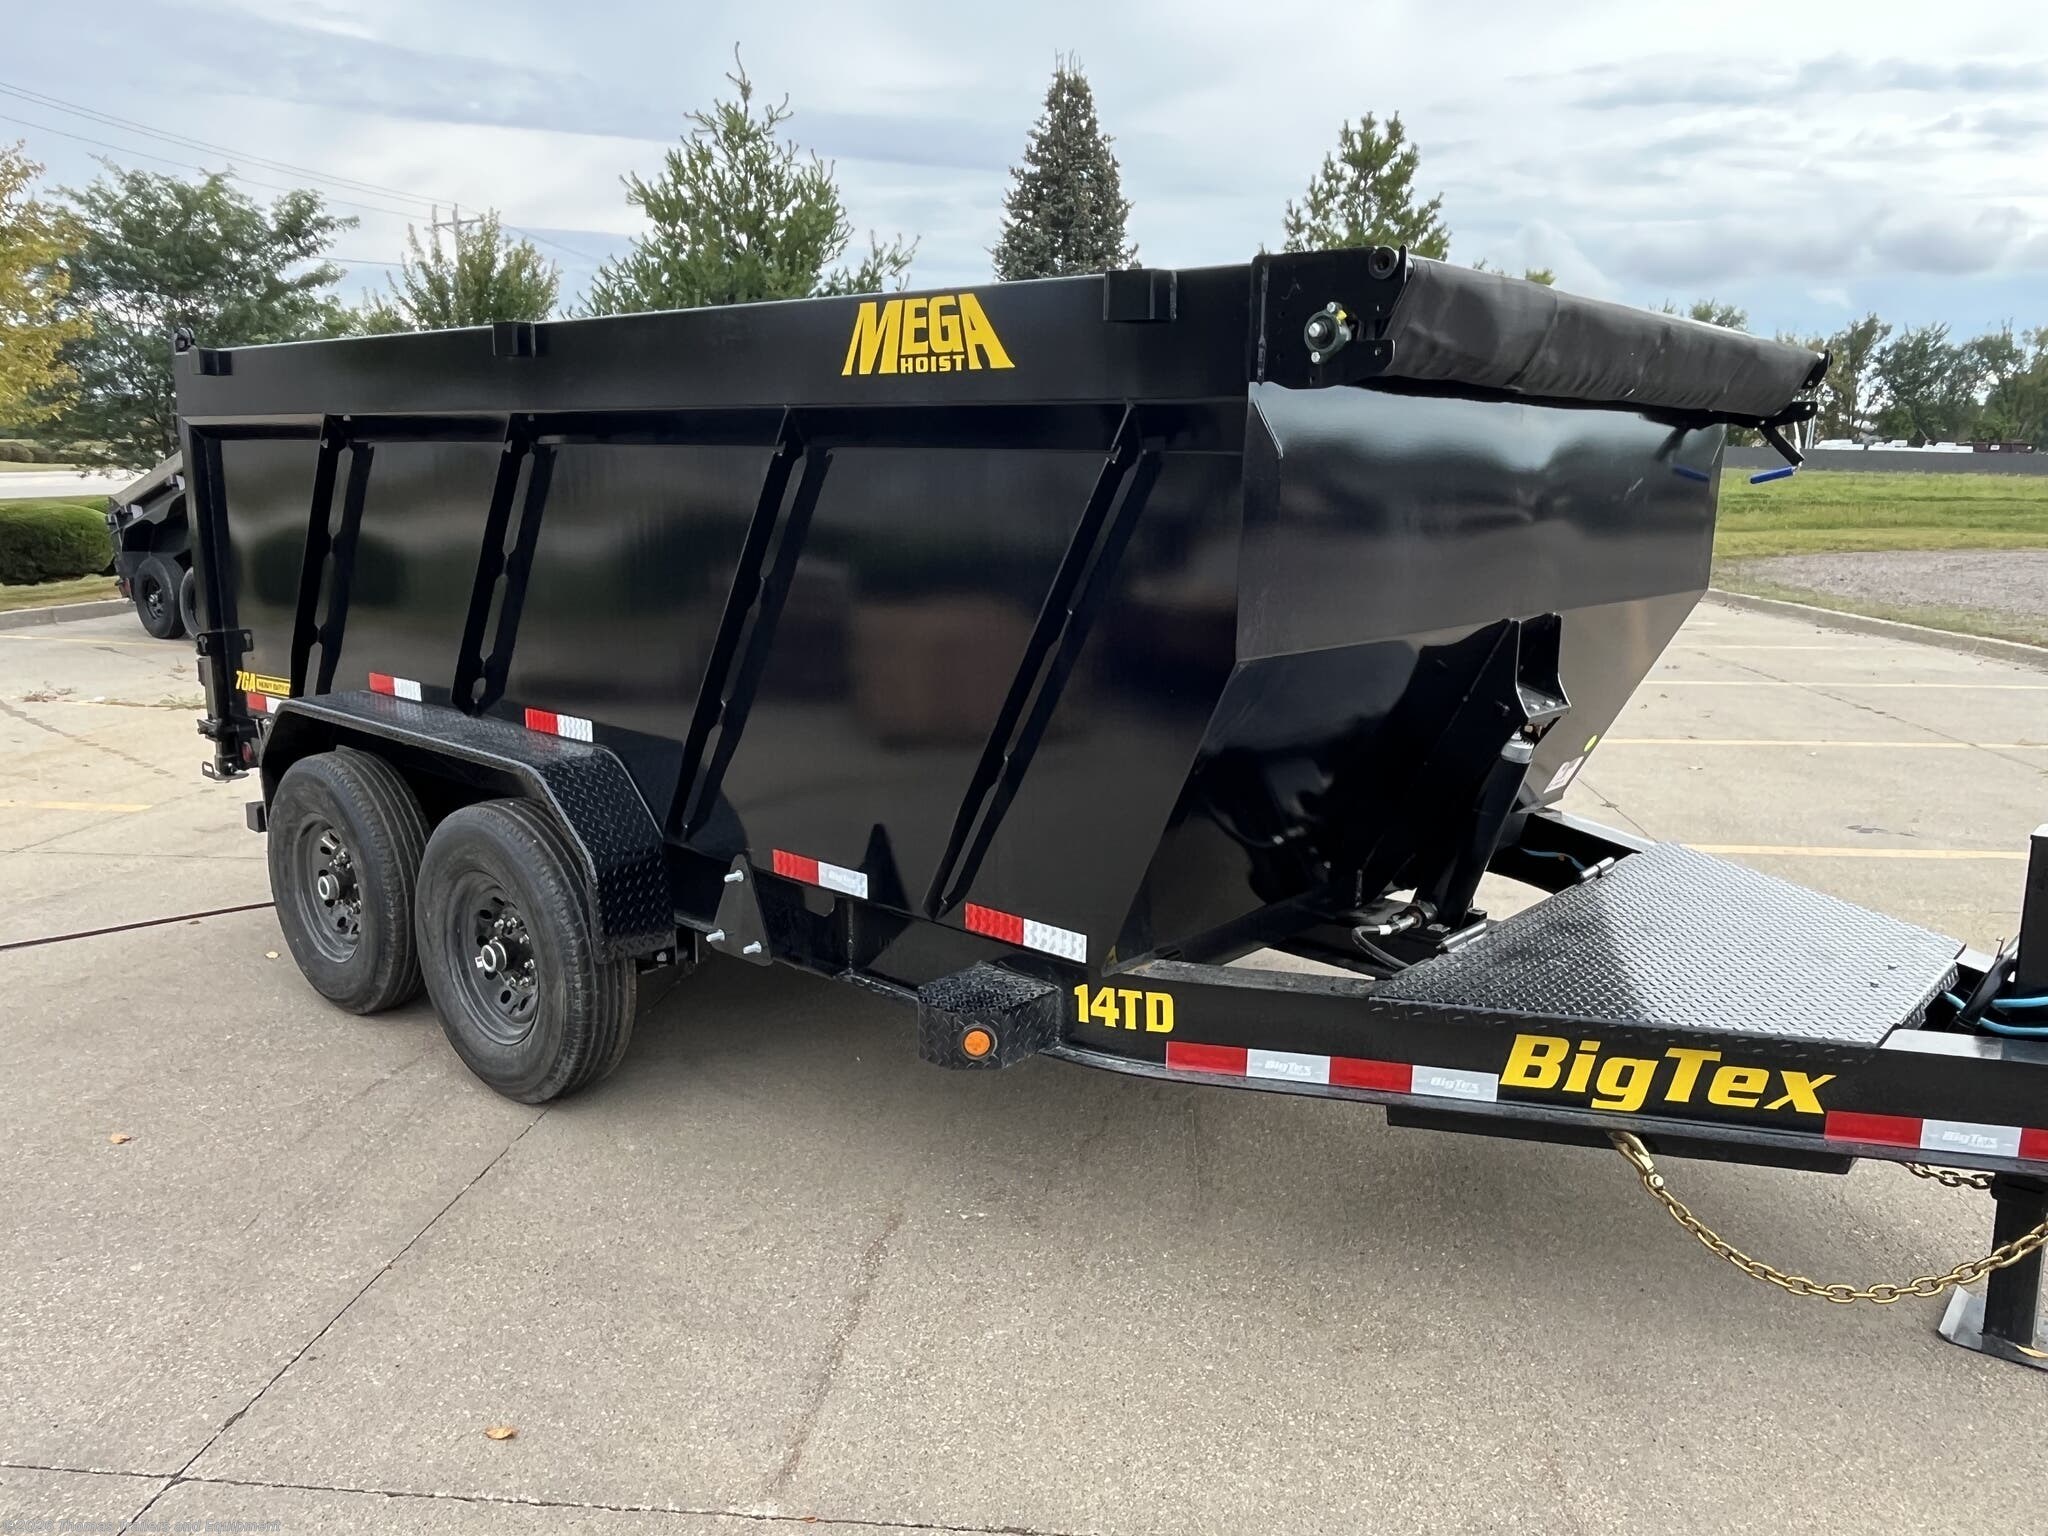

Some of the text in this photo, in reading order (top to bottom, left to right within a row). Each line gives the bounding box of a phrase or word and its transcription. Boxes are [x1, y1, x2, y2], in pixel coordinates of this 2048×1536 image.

[842, 293, 1015, 376] MEGA
[900, 354, 965, 374] HOIST
[235, 670, 257, 693] 7GA
[1074, 983, 1175, 1034] 14TD
[1499, 1033, 1837, 1115] BigTex
